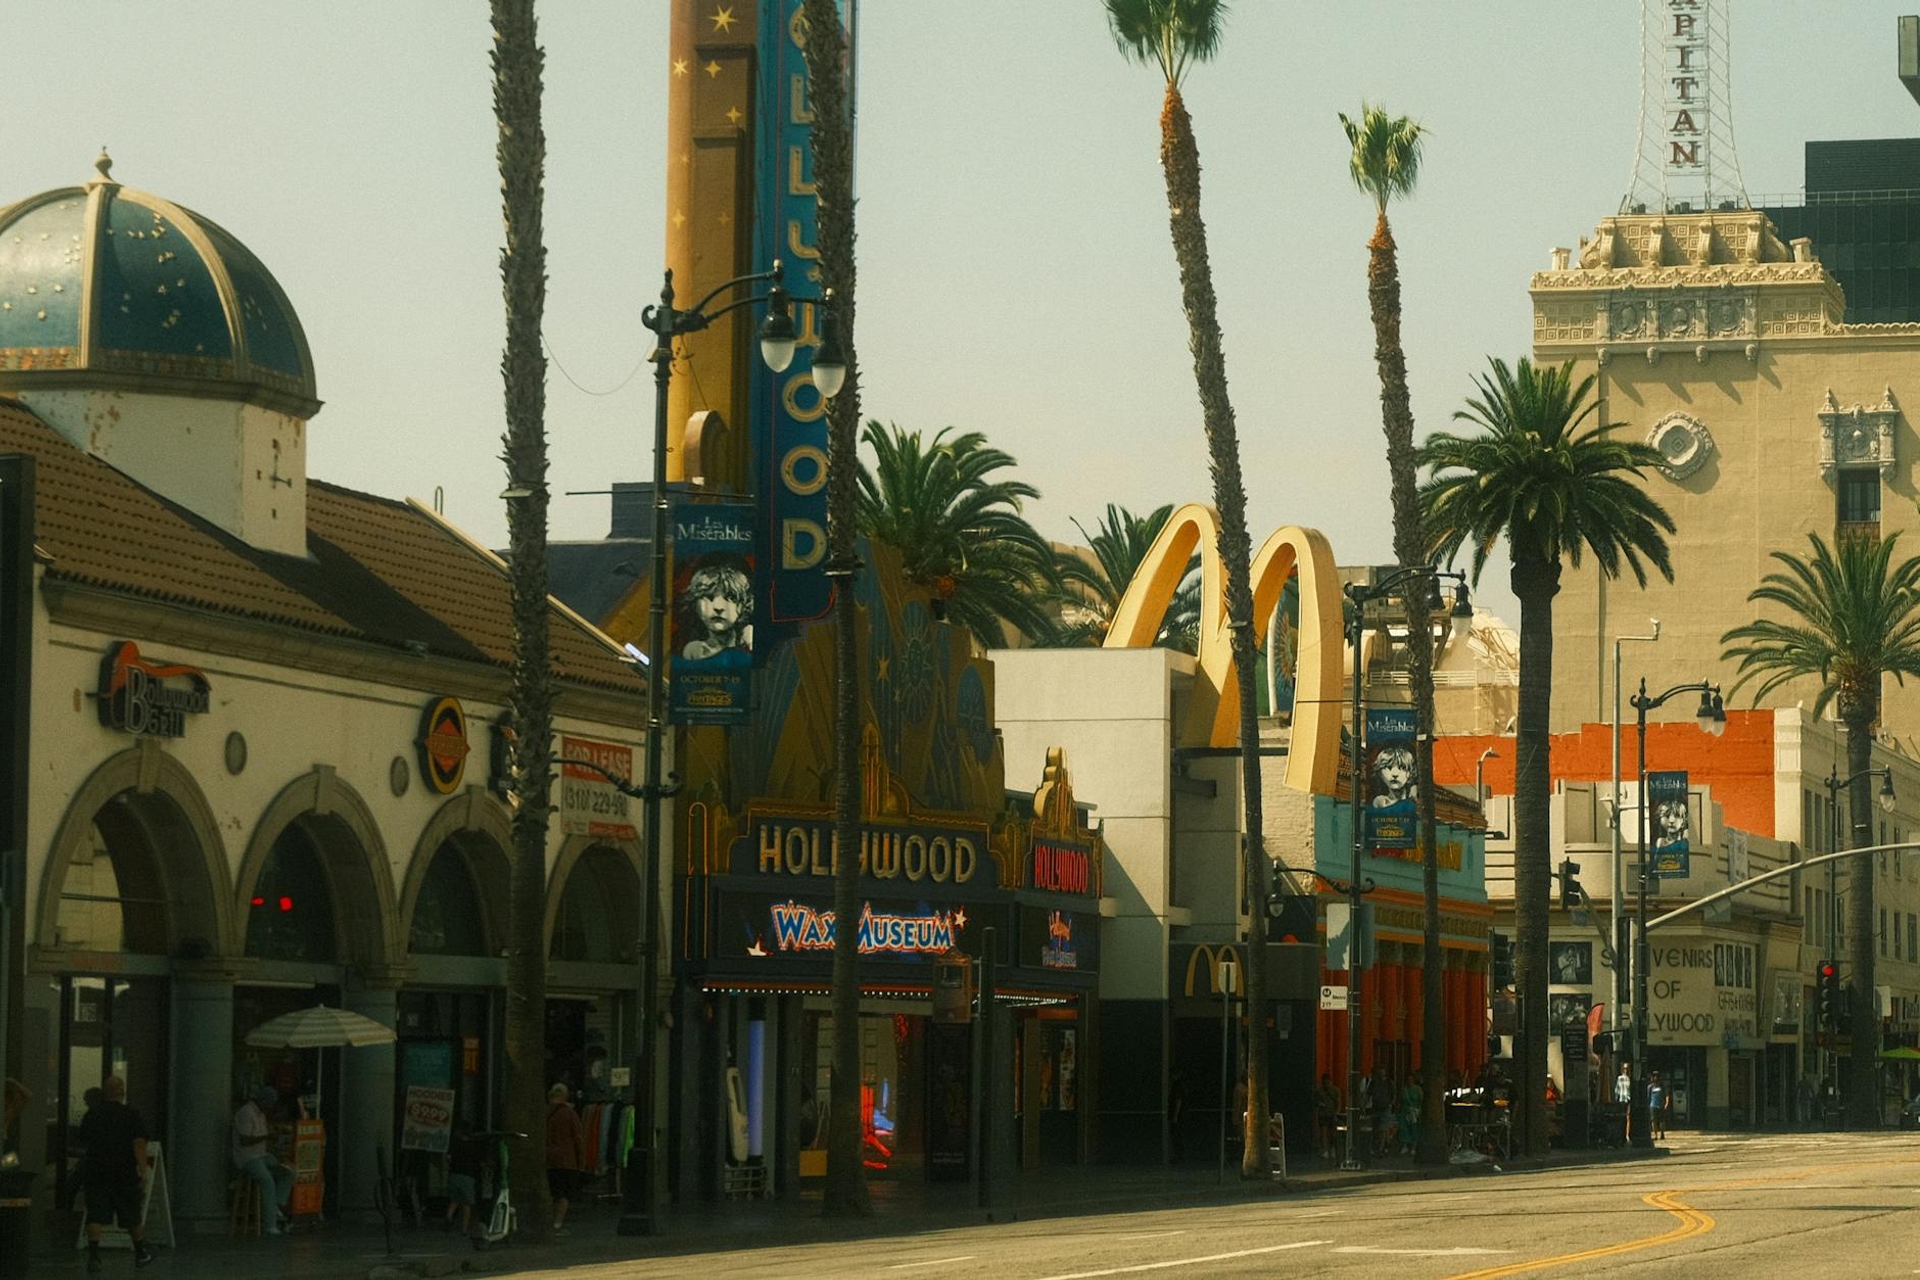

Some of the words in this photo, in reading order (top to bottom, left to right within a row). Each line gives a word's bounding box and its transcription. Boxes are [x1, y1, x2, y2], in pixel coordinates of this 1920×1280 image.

[1669, 0, 1702, 167] PITAN
[678, 522, 752, 541] Misérables
[704, 516, 723, 529] Les
[566, 745, 592, 773] FOR
[592, 749, 631, 782] LEASE
[1034, 844, 1088, 893] HOLLYWOOD
[1600, 947, 1713, 968] SVENIRS
[1653, 979, 1681, 999] OF
